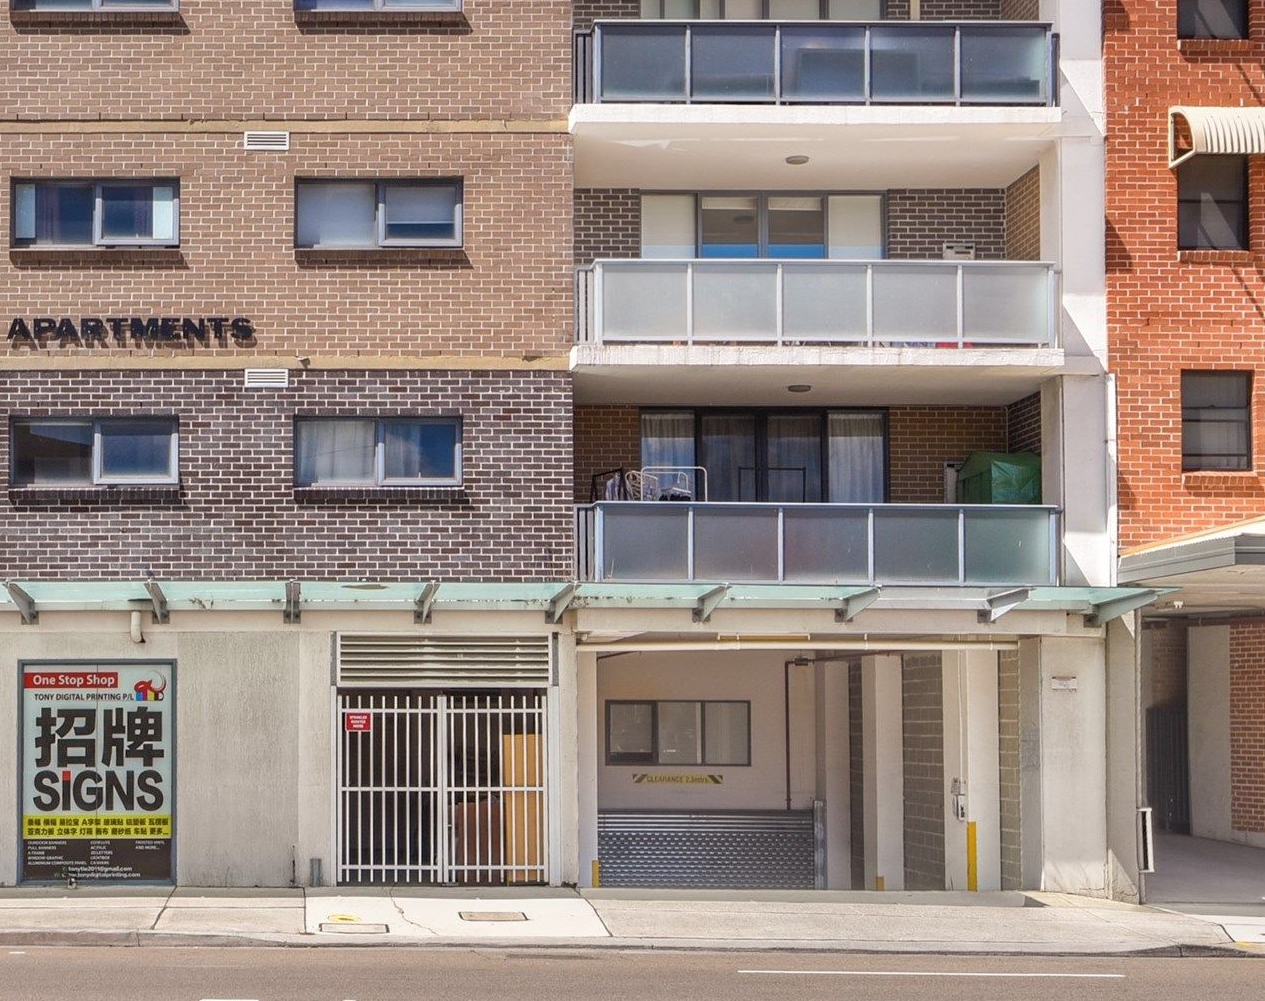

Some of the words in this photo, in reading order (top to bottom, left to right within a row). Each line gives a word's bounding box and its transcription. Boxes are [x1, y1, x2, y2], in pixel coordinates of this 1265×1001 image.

[7, 317, 253, 340] APARTMENTS
[33, 674, 55, 686] One
[57, 674, 83, 689] Stop
[85, 674, 115, 688] Shop
[56, 693, 85, 701] DIGITAL
[86, 693, 121, 701] PRINTING
[122, 693, 134, 701] P/L
[35, 706, 165, 768] 招牌
